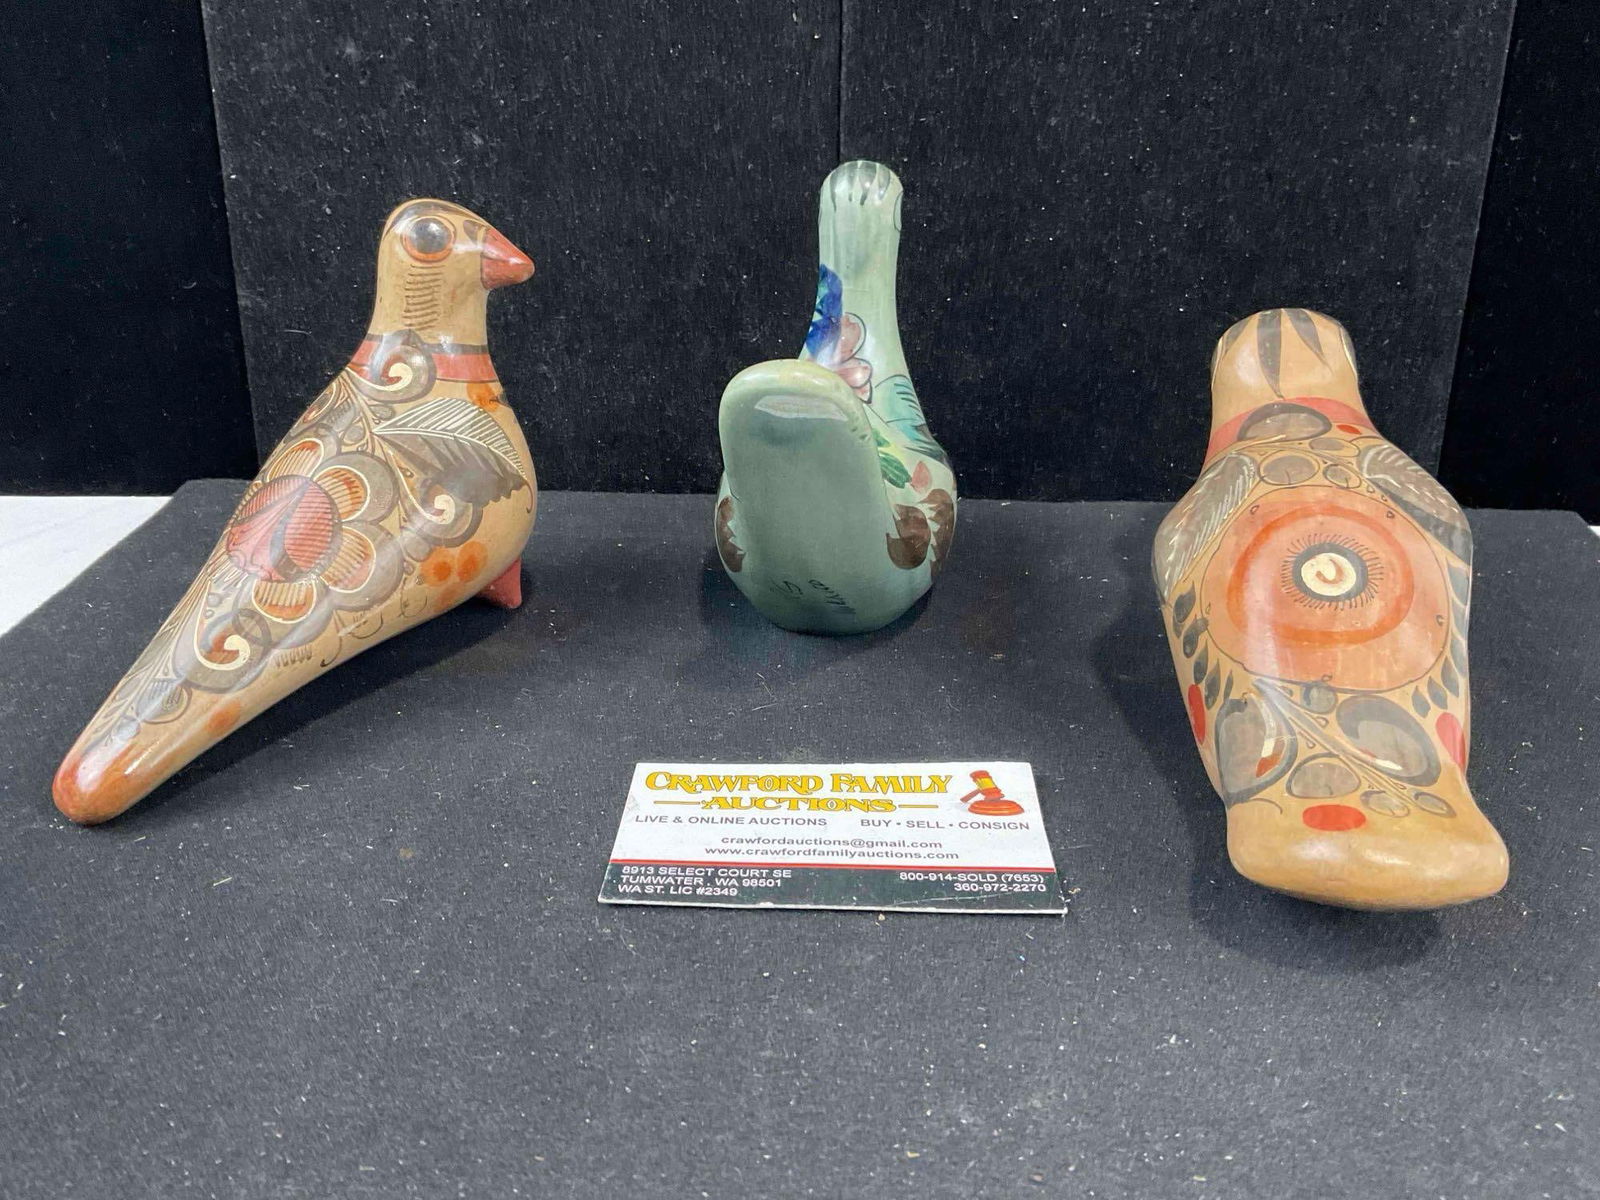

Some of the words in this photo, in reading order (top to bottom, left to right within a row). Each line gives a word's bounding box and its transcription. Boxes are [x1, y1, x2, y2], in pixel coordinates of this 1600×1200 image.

[645, 771, 824, 795] CRAWFORD
[830, 773, 953, 795] FAMILY
[701, 797, 897, 812] AUCTIONS
[635, 815, 669, 824] LIVE
[672, 816, 684, 824] &
[688, 816, 745, 825] ONLINE
[748, 817, 827, 826] AUCTIONS
[860, 818, 892, 828] BUY
[905, 820, 945, 829] SELL
[958, 821, 1030, 831] CONSIGN
[721, 836, 943, 849] crawfordauctions@gmail.com
[704, 847, 959, 860] www.crawfordfamilyauctions.com
[657, 867, 715, 876] SELECT
[717, 868, 770, 877] COURT
[772, 869, 792, 878] SE
[899, 872, 998, 883] 800-914-SOLD
[1000, 873, 1045, 884] (7653)
[714, 877, 740, 887] WA
[741, 878, 782, 888] 98501
[953, 882, 1047, 892] 360-972-2270
[618, 885, 642, 894] WA
[643, 886, 665, 895] ST.
[670, 886, 693, 895] LIC
[695, 887, 738, 896] #2349
